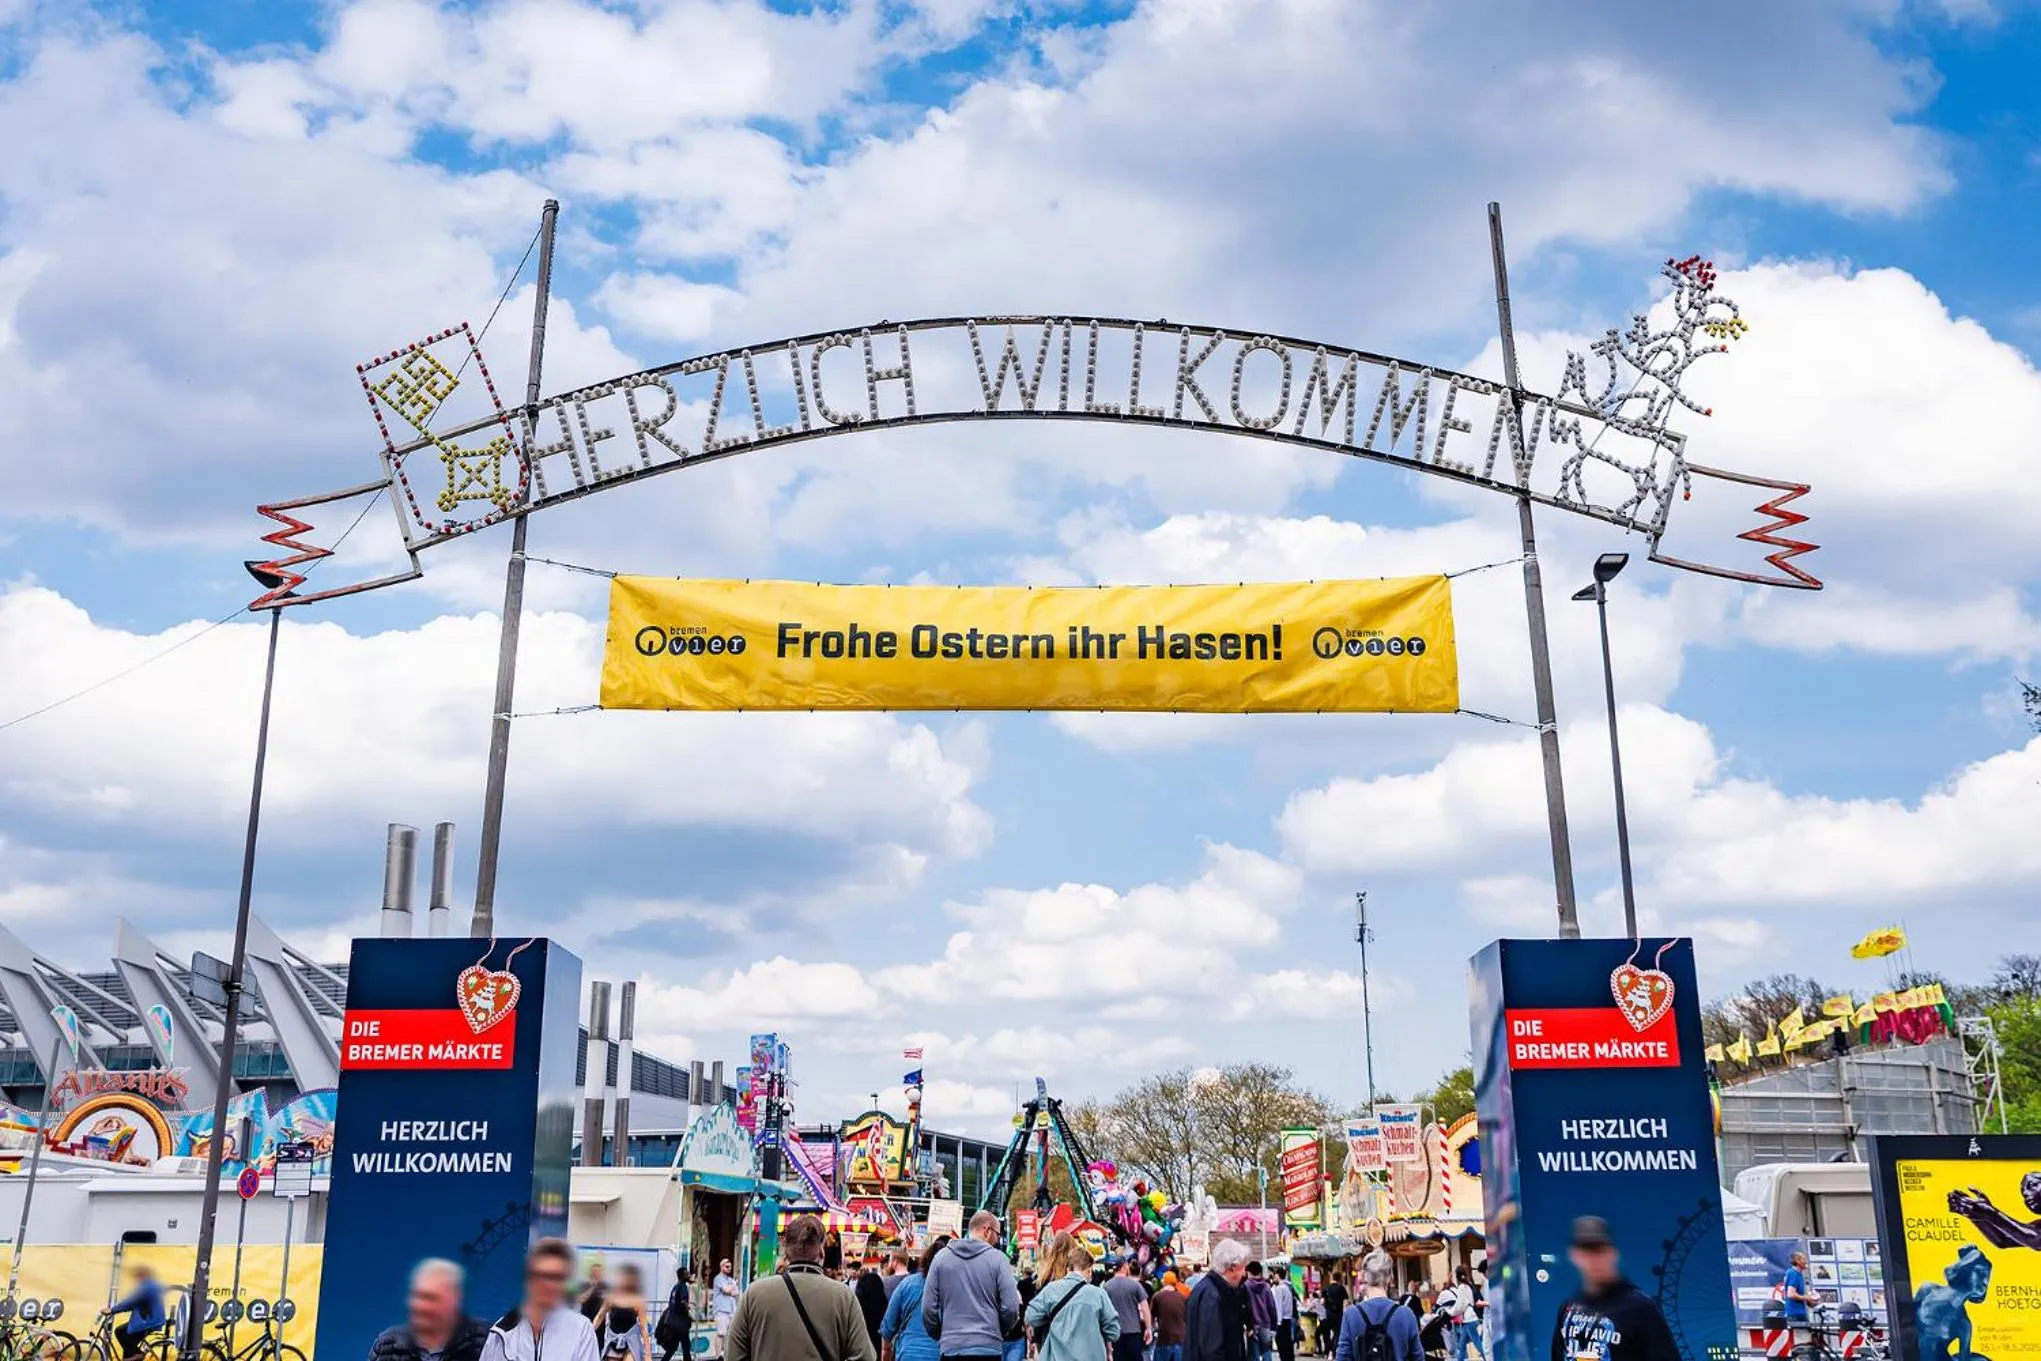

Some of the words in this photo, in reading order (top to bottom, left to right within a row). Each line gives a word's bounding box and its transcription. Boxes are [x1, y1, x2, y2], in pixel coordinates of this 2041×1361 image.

[518, 323, 916, 498] HERZLICH
[967, 318, 1547, 489] WILLKOMMEN
[669, 625, 708, 635] bremen
[1346, 627, 1384, 637] bremen
[777, 622, 897, 659] Frohe
[911, 623, 1055, 660] Ostern
[1068, 625, 1126, 660] ihr
[1138, 624, 1283, 661] Hasen!
[350, 1020, 381, 1038] DIE
[1513, 1019, 1544, 1037] DIE
[348, 1044, 424, 1061] BREMER
[427, 1040, 504, 1060] MÄRKTE
[1515, 1043, 1591, 1060] BREMER
[1594, 1038, 1669, 1059] MÄRKTE
[52, 1068, 191, 1108] Atlantis
[380, 1120, 489, 1142] HERZLICH
[1561, 1118, 1669, 1140] HERZLICH
[352, 1152, 513, 1174] WILLKOMMEN
[1537, 1149, 1698, 1173] WILLKOMMEN
[1905, 1217, 1961, 1230] CAMILLE
[1907, 1230, 1966, 1242] CLAUDEL
[1996, 1285, 2041, 1297] BERNH
